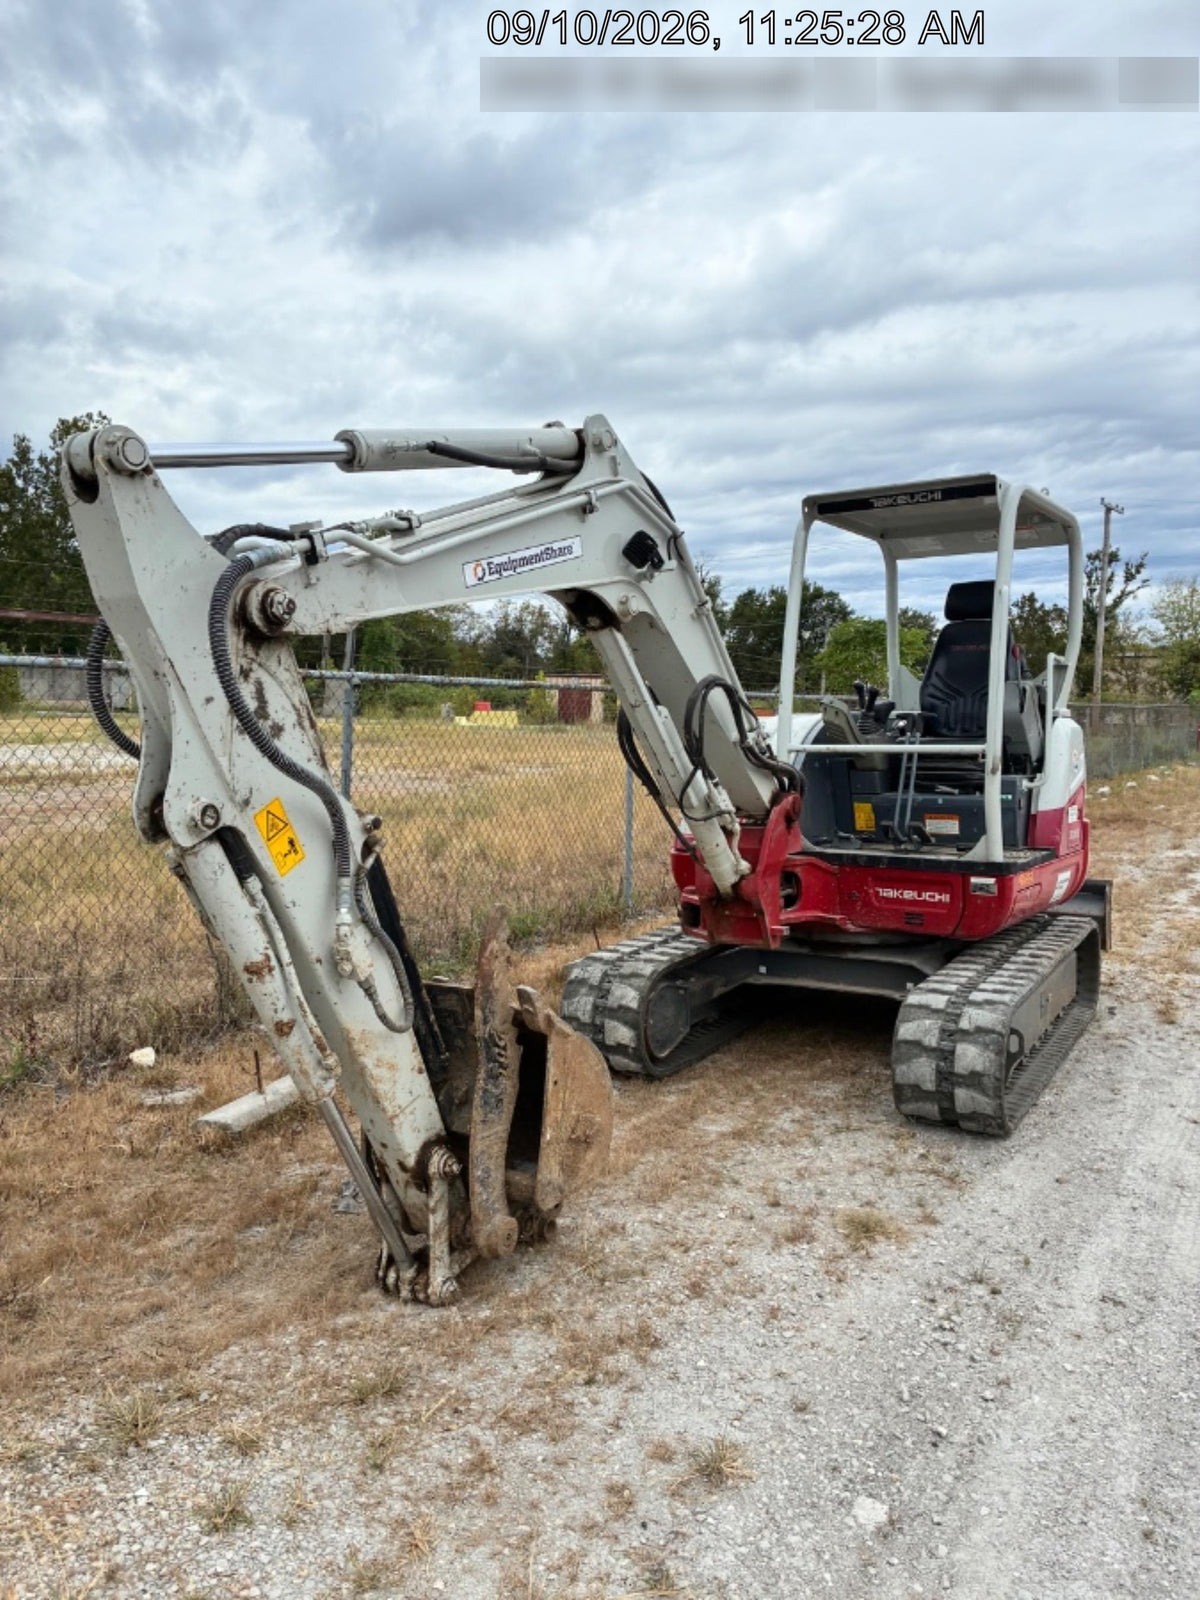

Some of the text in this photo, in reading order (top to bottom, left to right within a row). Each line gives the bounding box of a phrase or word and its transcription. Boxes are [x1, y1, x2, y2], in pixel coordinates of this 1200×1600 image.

[869, 490, 942, 508] TAKEUCHI
[486, 543, 574, 577] EquipmentShare
[875, 887, 950, 904] TAKEUCHI
